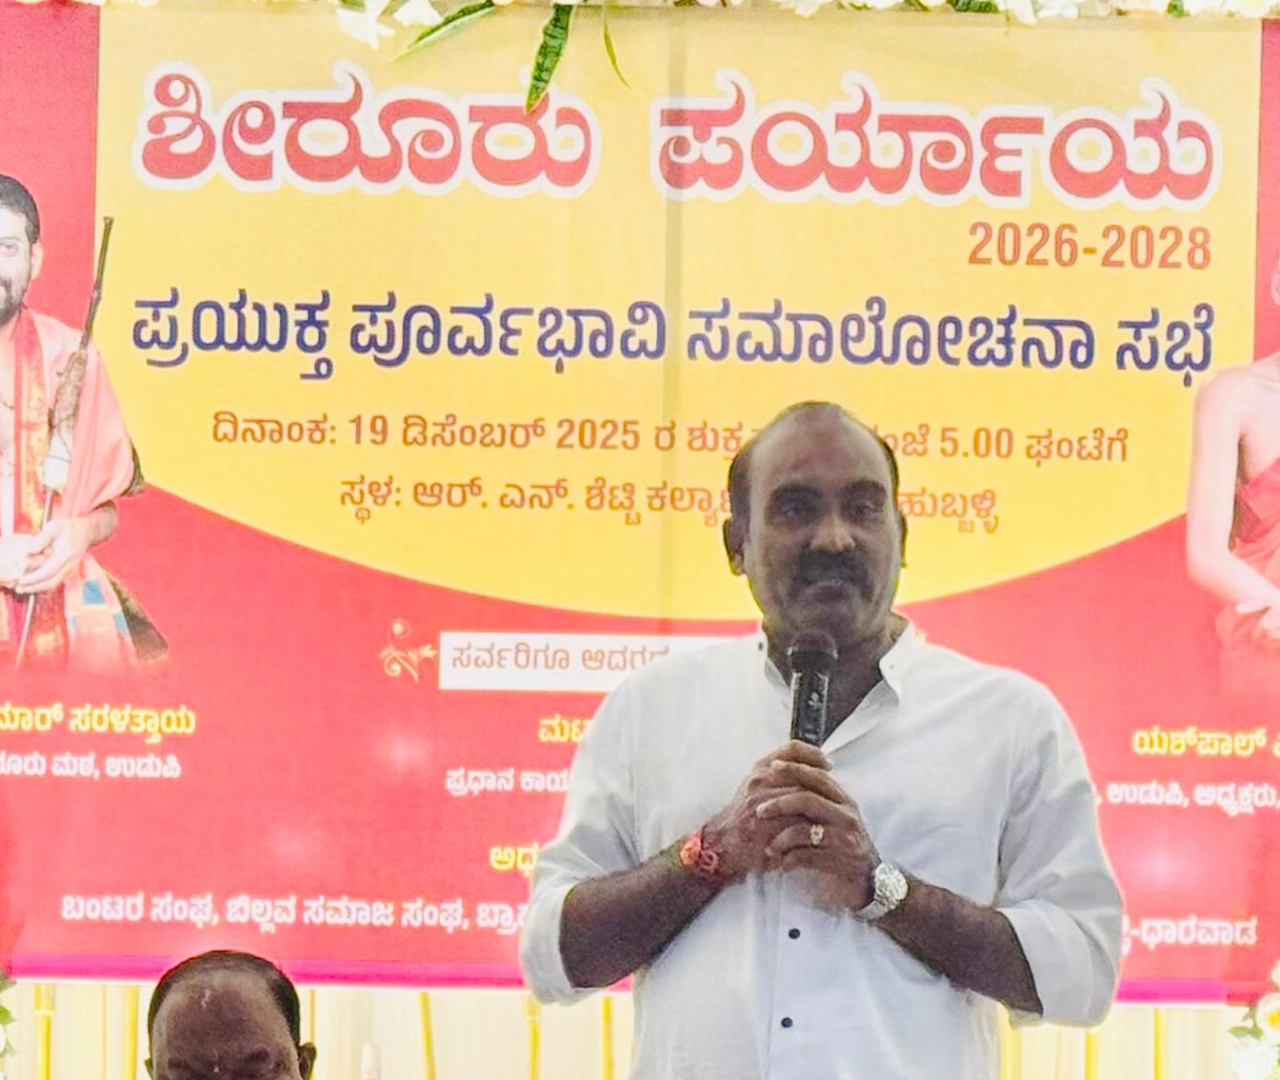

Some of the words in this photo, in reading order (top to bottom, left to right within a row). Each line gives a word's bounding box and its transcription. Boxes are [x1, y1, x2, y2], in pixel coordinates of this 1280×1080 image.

[139, 70, 595, 190] ಶೀರೂರು
[656, 76, 1216, 202] ಪರ್ಯಾಯ
[966, 221, 1213, 271] 2026-2028
[131, 286, 334, 381] ಪ್ರಯುಕ್ತ
[348, 291, 668, 375] ಪೂರ್ವಭಾವಿ
[686, 296, 1096, 369] ಸಮಾಲೋಚನಾ
[1115, 302, 1215, 388] ಸಭೆ
[211, 410, 338, 446] ದಿನಾಂಕ:
[347, 414, 389, 446] 19
[401, 414, 547, 450] ಡಿಸೆಂಬರ್
[555, 418, 641, 452] 2025
[653, 420, 677, 453] ರ
[686, 420, 761, 461] ಶುಕ್ರ
[939, 426, 1015, 460] 5.00
[1024, 426, 1130, 468] ಘಂಟೆಗೆ
[339, 473, 402, 525] ಸ್ಥಳ:
[411, 476, 489, 510] ಆರ್.
[498, 477, 575, 512] ಎನ್.
[585, 477, 641, 526] ಶೆಟ್ಟಿ
[450, 641, 571, 671] ಸರ್ವರಿಗೂ
[69, 703, 197, 744] ಸರಳತ್ತಾಯ
[51, 750, 101, 780] ಮಠ,
[104, 752, 182, 779] ಉಡುಪಿ
[444, 765, 516, 797] ಪ್ರಧಾನ
[1106, 780, 1190, 809] ಉಡುಪಿ,
[60, 890, 144, 922] ಬಂಟರ
[149, 891, 220, 928] ಸಂಘ,
[225, 894, 297, 935] ಬಿಲ್ಲವ
[302, 894, 395, 928] ಸಮಾಜ
[400, 896, 470, 932] ಸಂಘ,
